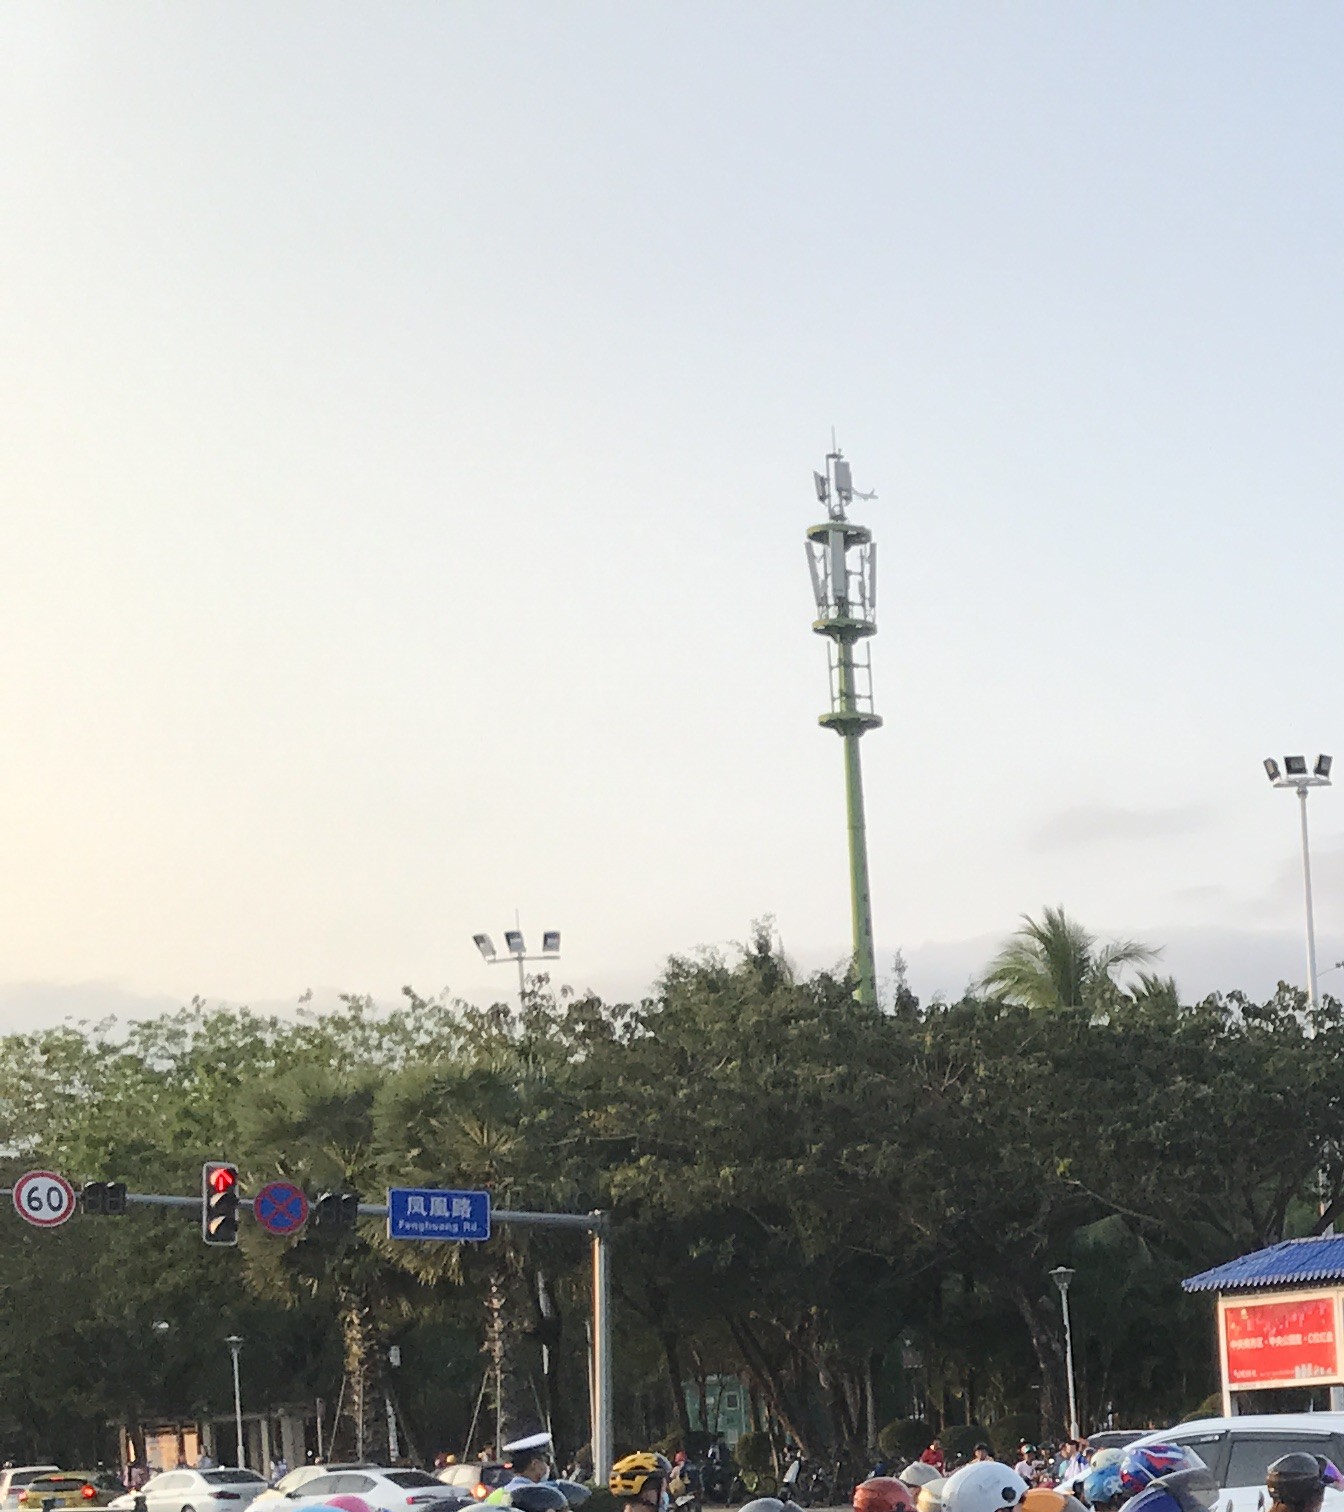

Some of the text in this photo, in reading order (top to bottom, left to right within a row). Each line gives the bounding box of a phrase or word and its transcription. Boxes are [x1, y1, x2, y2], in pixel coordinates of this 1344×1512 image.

[27, 1186, 63, 1212] 60
[406, 1196, 472, 1220] 凤凰路
